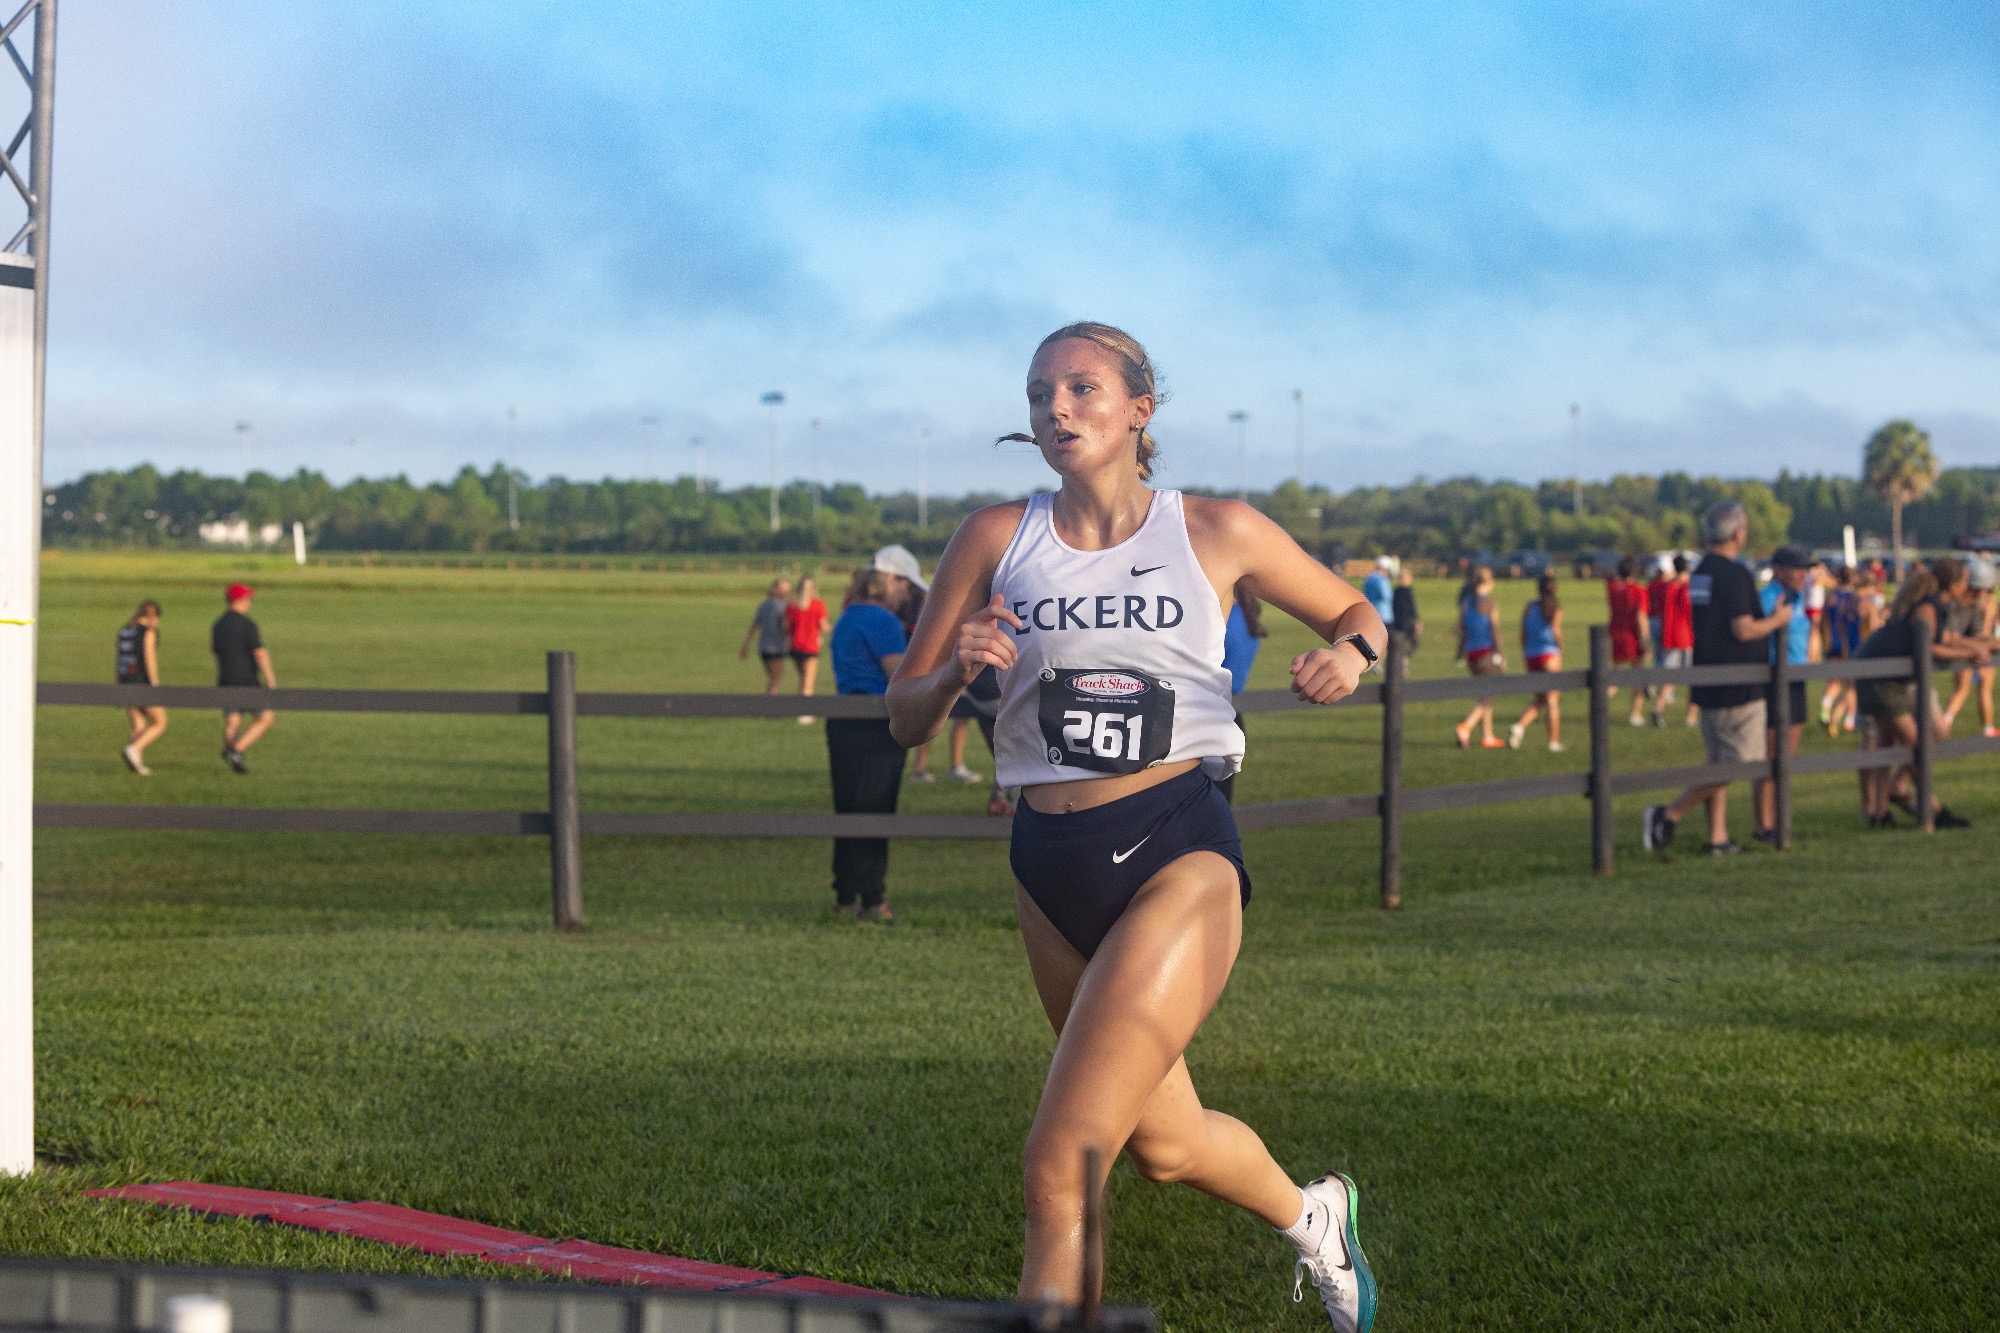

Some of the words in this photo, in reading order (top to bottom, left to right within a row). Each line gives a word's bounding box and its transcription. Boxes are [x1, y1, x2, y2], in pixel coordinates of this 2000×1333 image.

[1012, 595, 1184, 636] ECKERD
[1073, 677, 1106, 688] Track
[1107, 678, 1144, 691] Shack
[1062, 710, 1143, 761] 261
